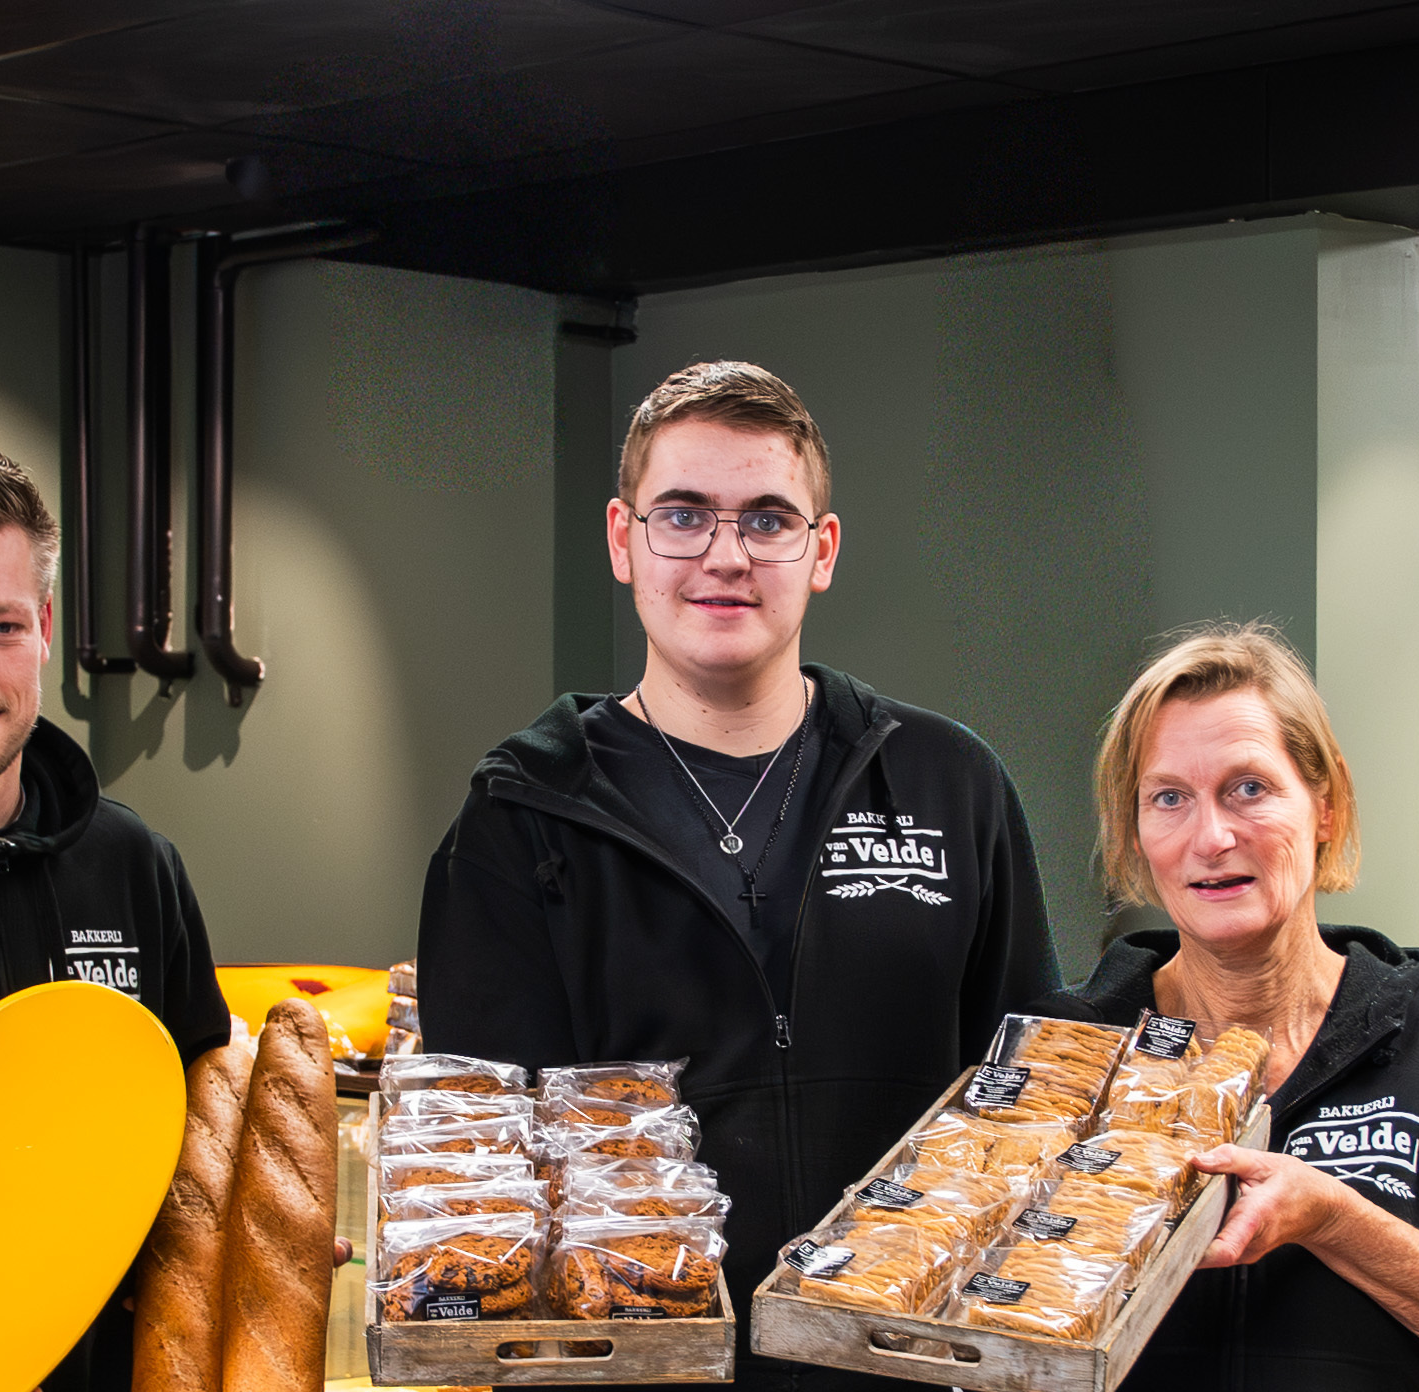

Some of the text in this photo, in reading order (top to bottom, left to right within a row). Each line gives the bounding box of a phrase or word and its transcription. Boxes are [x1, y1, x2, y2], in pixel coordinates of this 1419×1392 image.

[825, 837, 934, 867] van de Velde
[70, 929, 123, 943] BAKKERIJ
[73, 958, 138, 989] Velde
[1318, 1096, 1396, 1119] BAKKERIJ
[1290, 1121, 1412, 1157] van de Velde
[438, 1305, 473, 1318] Velde
